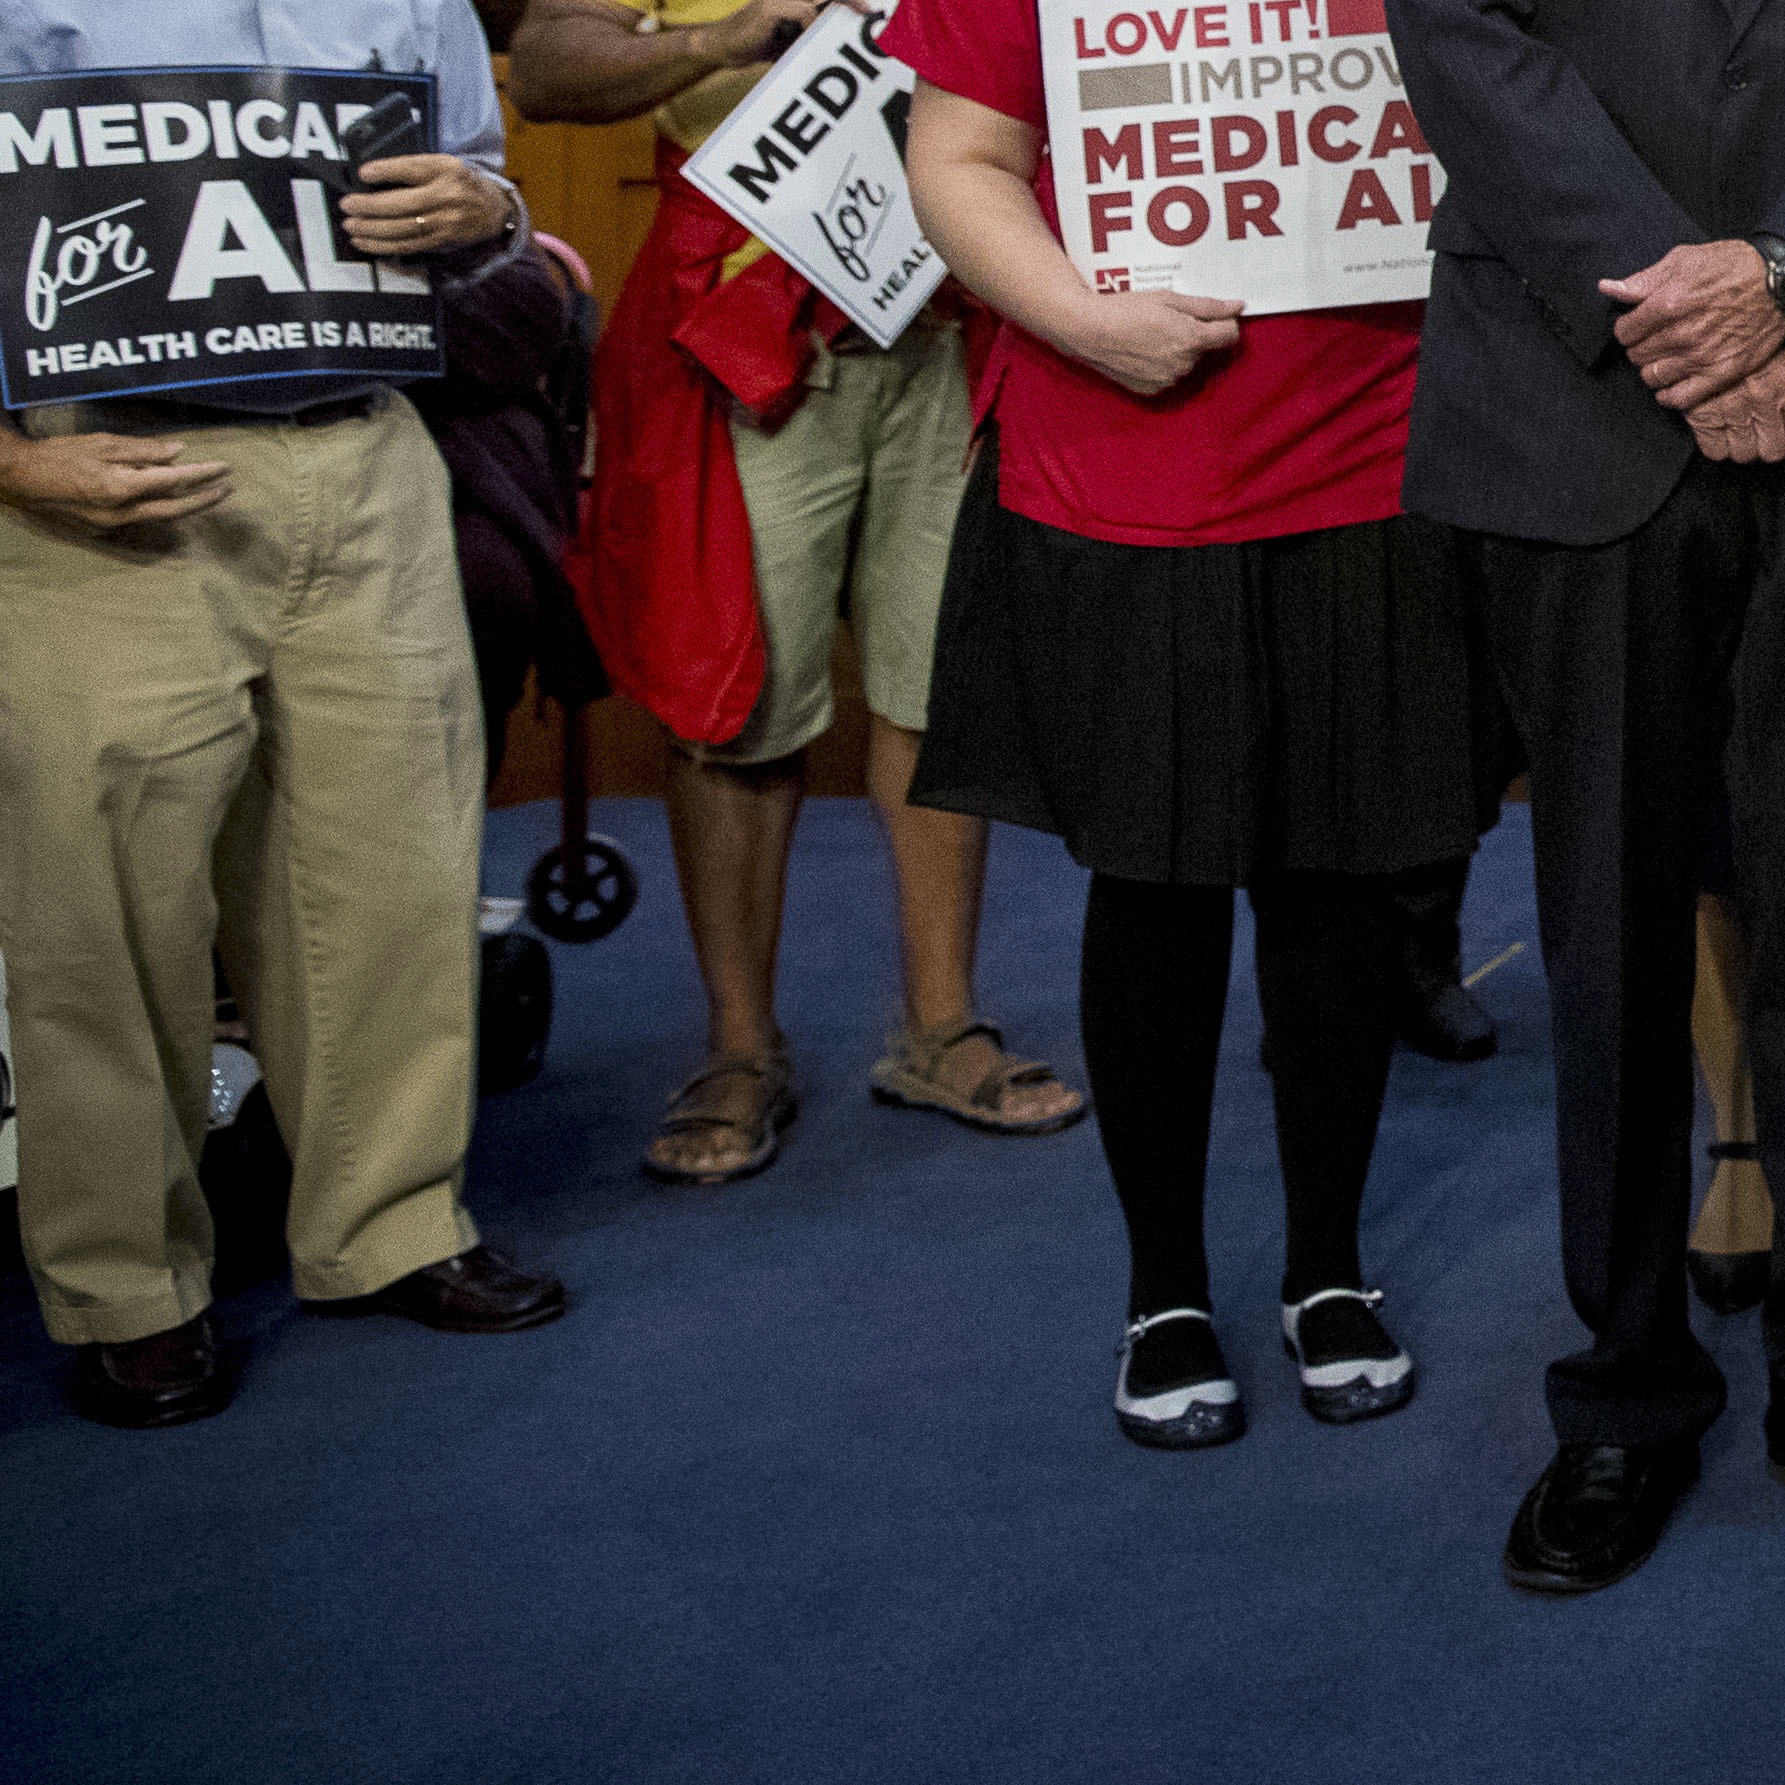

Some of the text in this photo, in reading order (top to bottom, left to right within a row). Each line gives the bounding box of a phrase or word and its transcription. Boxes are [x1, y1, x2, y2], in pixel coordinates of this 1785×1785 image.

[1075, 5, 1231, 59] LOVE
[1179, 46, 1404, 105] IMPROV
[0, 99, 421, 173] MEDICA
[1082, 100, 1432, 185] MEDICA
[813, 179, 887, 281] for
[1088, 163, 1434, 254] FOR AL
[26, 216, 147, 331] for
[872, 247, 931, 310] HEAL
[26, 321, 437, 377] HEALTH CARE IS A RIGHT.
